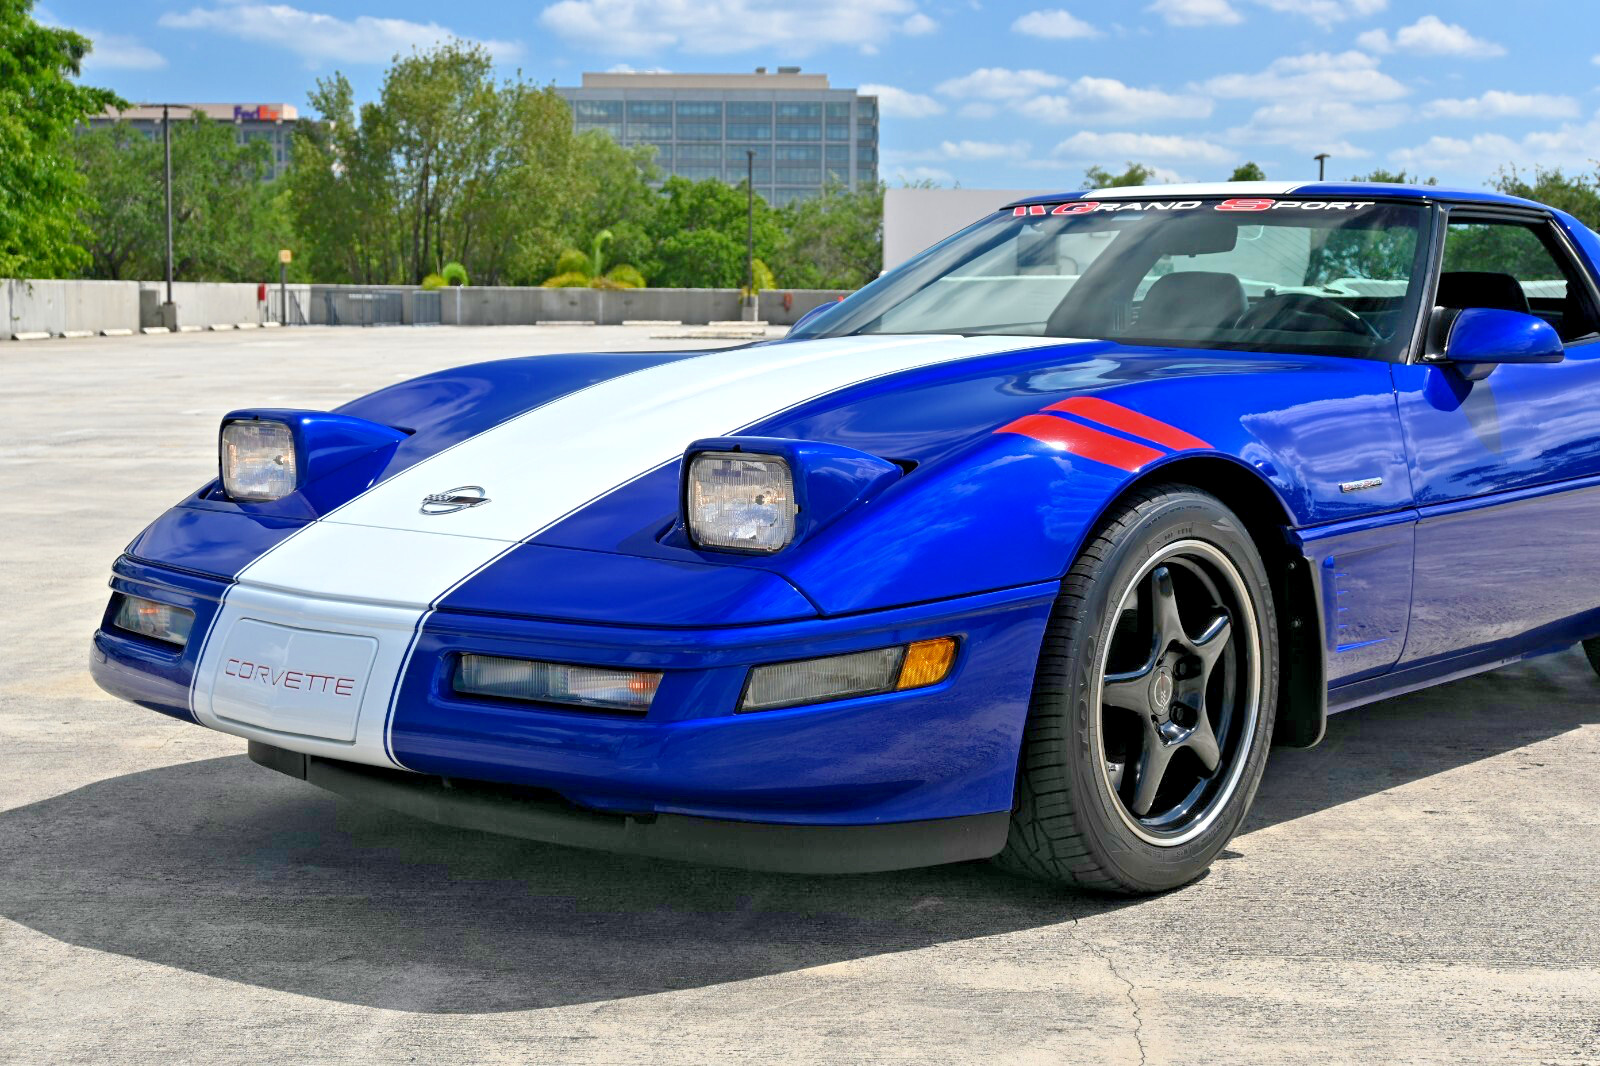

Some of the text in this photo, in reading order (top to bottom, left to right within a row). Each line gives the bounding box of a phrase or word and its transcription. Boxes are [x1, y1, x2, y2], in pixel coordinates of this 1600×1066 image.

[1051, 198, 1376, 215] GRAND SPORT
[225, 658, 355, 696] CORVETTE
